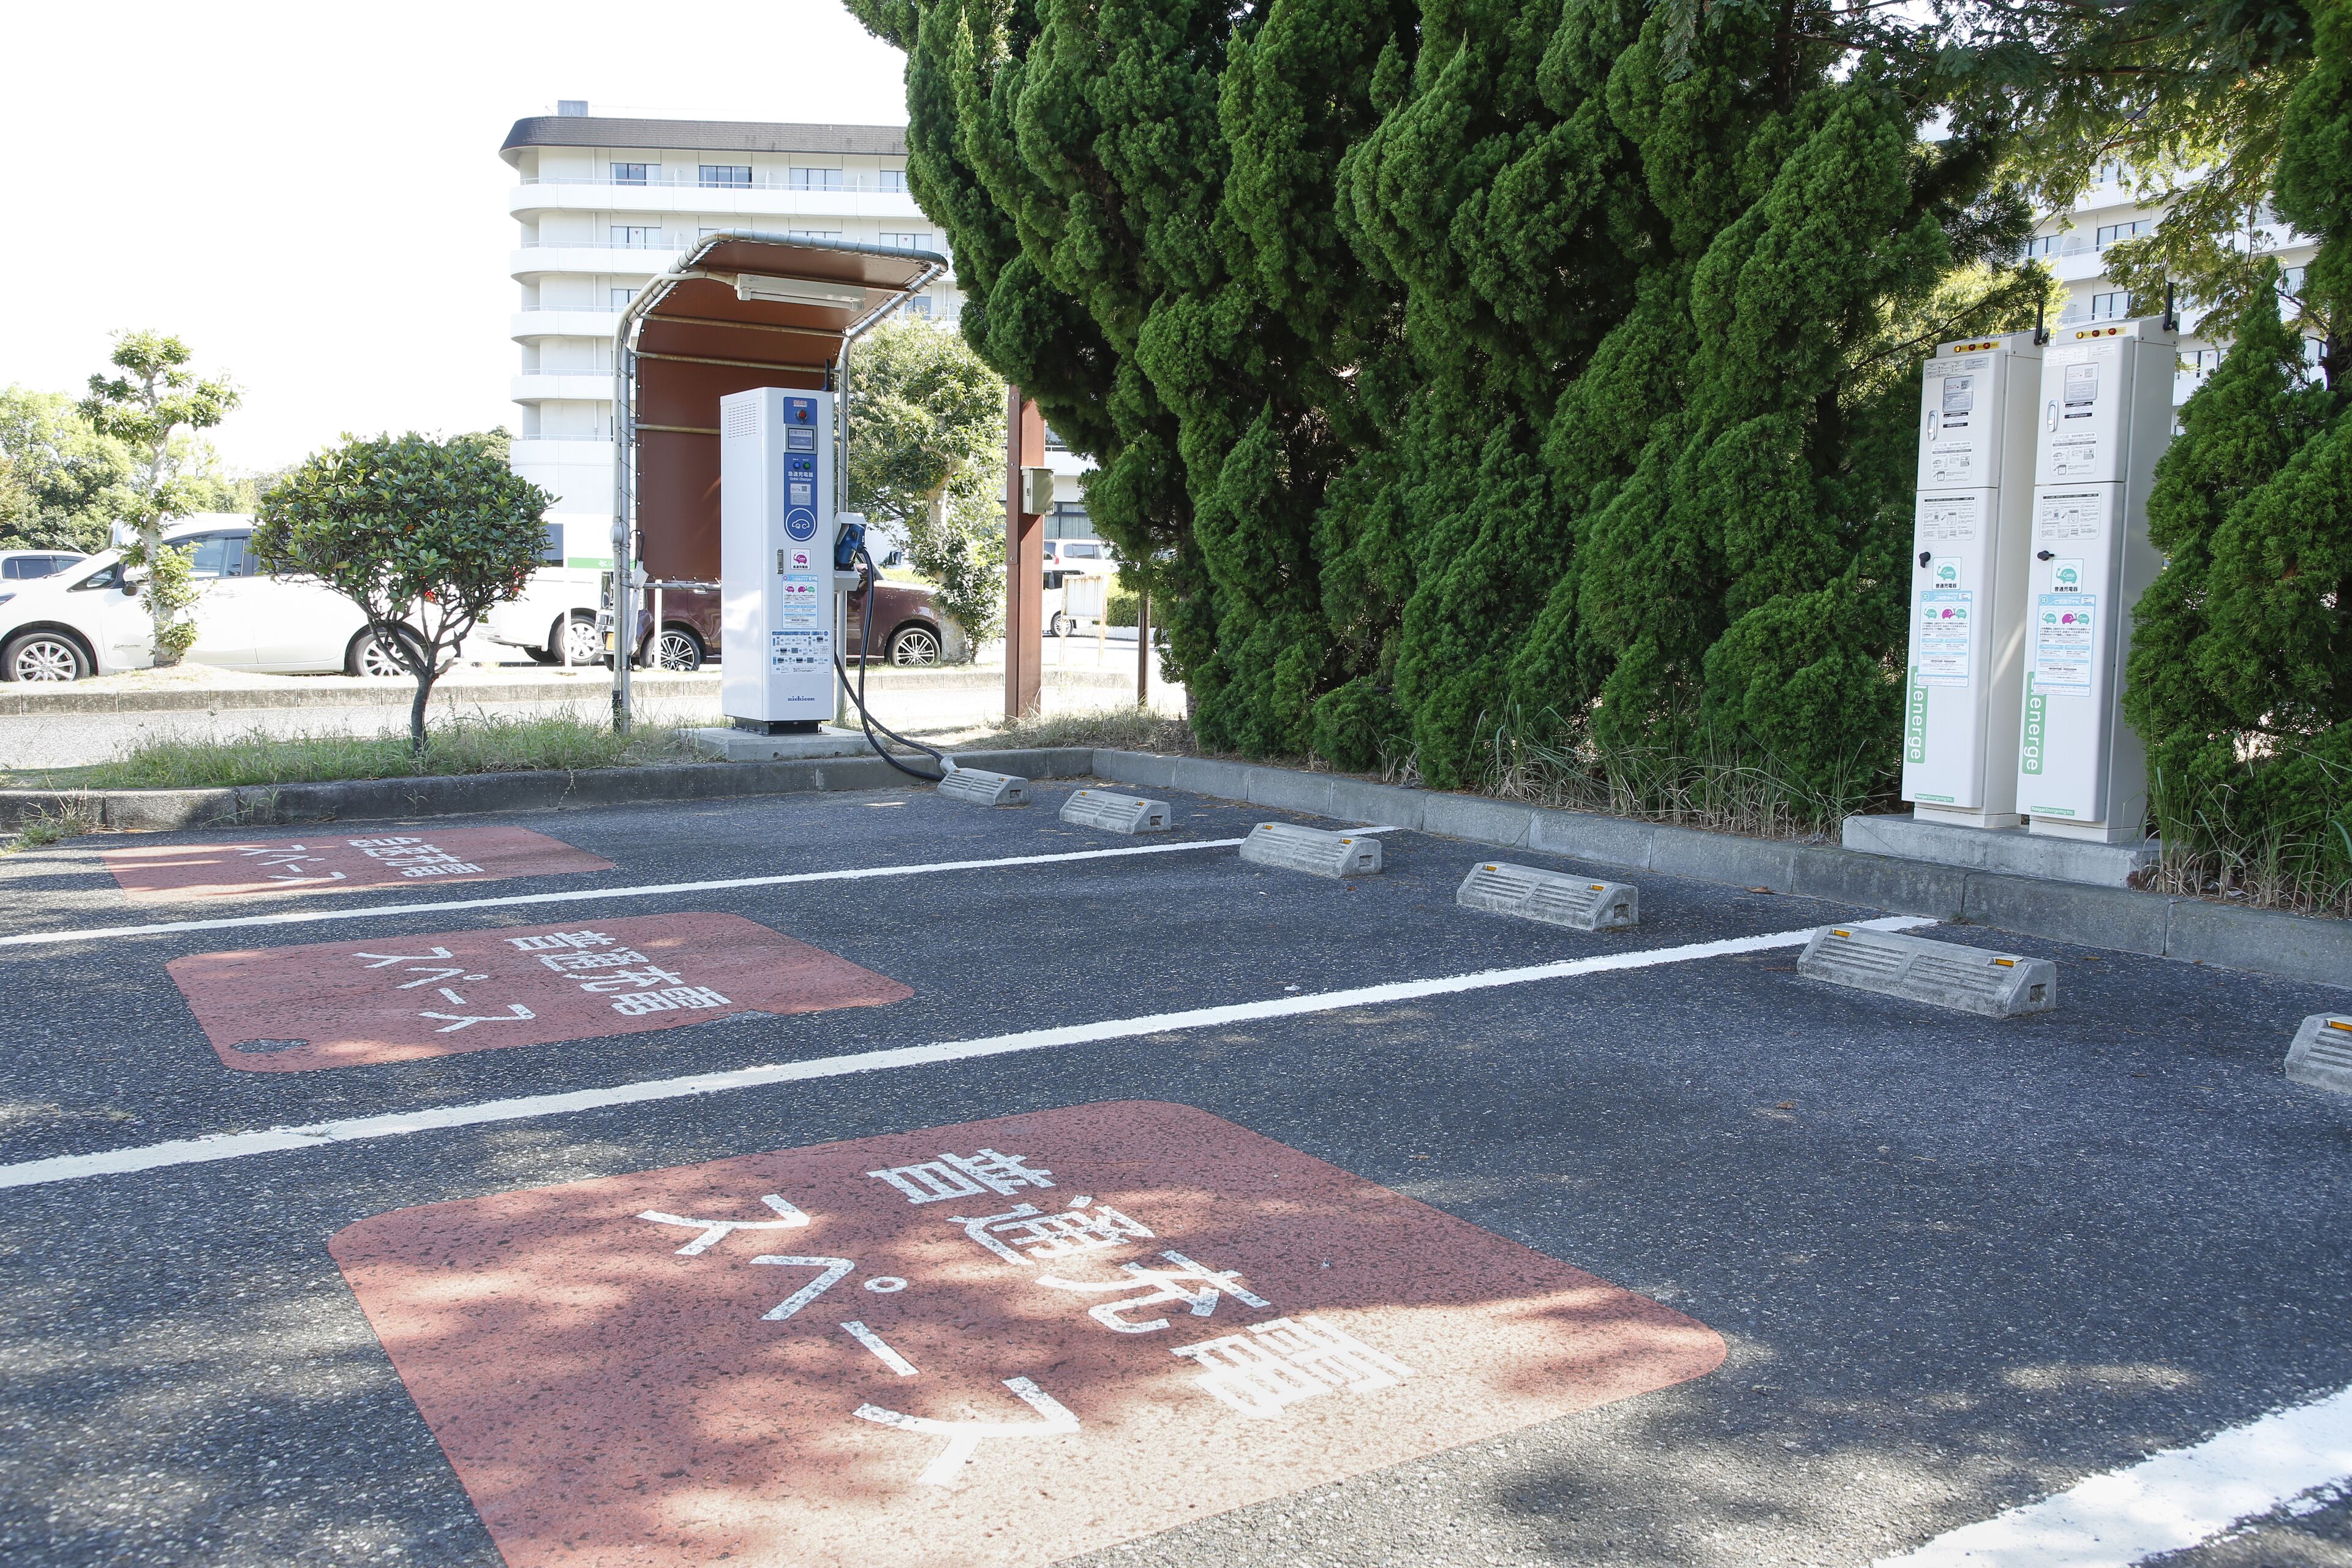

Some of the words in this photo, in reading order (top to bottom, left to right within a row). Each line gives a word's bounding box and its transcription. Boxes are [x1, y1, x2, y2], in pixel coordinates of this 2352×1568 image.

[236, 845, 347, 884] スペース
[347, 837, 485, 877] 急速充電
[352, 947, 535, 1033] スペース
[503, 930, 733, 1016] 普通充電
[867, 1148, 1414, 1419] 普通充電
[636, 1193, 1080, 1486] スペース
